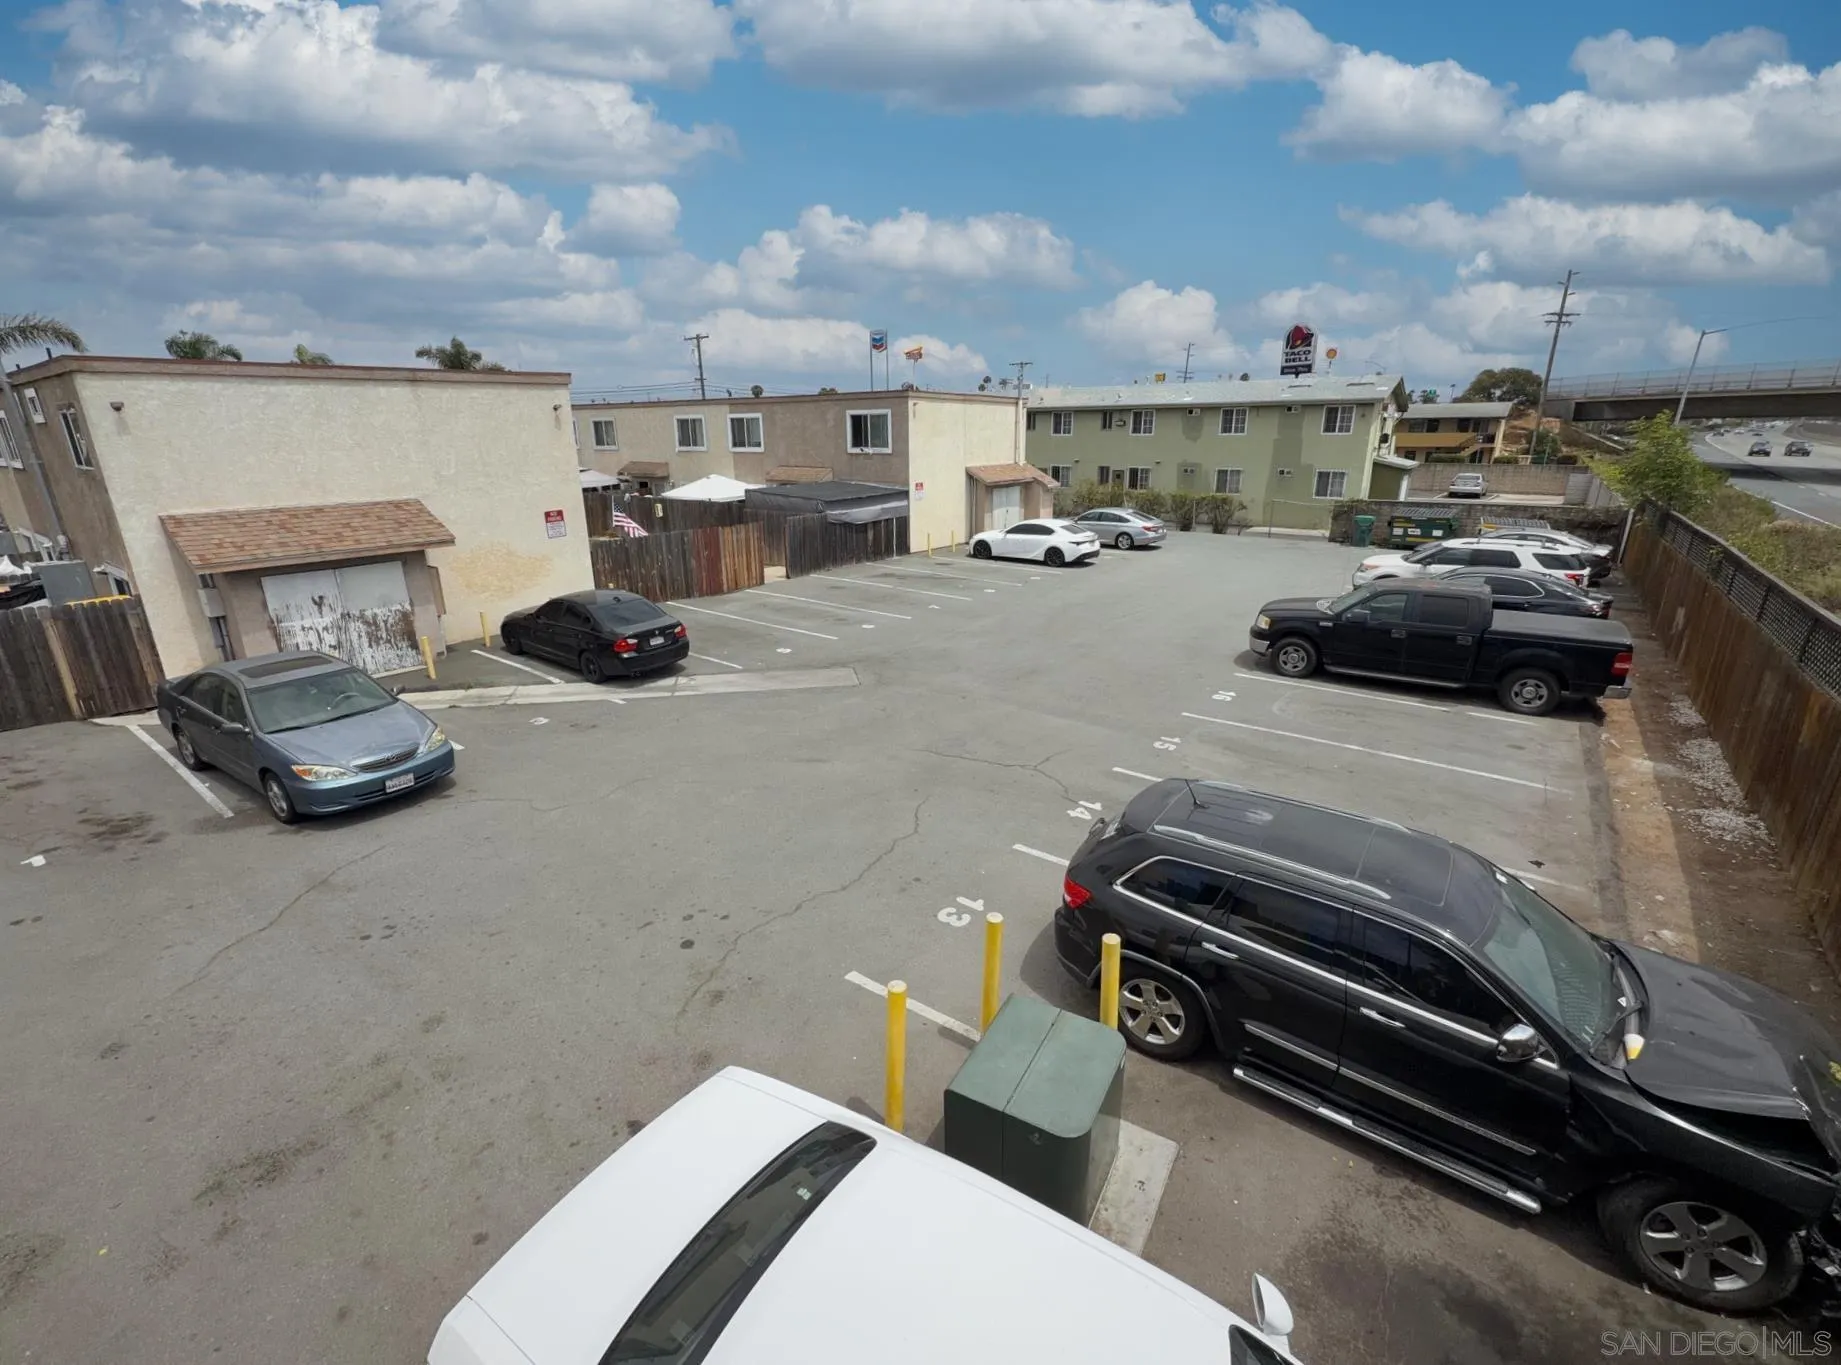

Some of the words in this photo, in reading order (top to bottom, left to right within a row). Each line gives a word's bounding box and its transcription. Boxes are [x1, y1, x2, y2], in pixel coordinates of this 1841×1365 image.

[1153, 736, 1181, 751] 15
[1067, 800, 1102, 820] 14
[937, 896, 985, 927] 13
